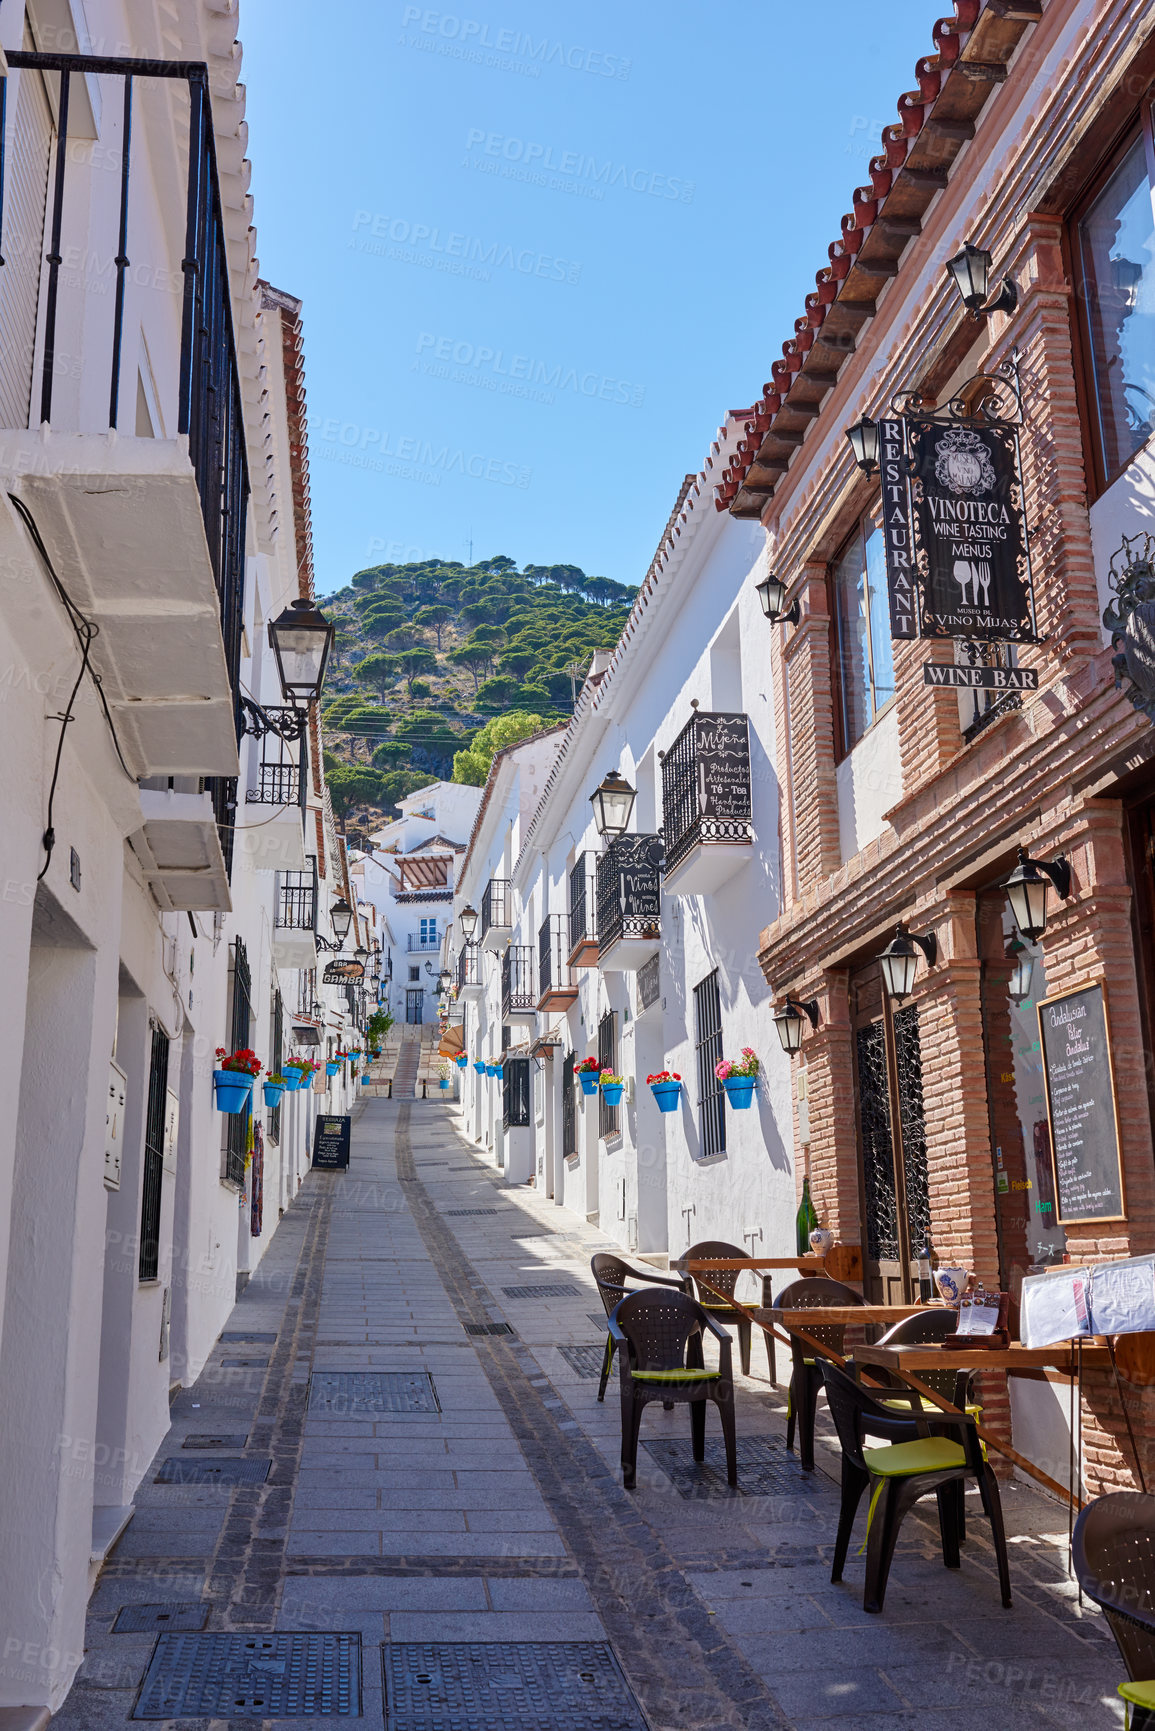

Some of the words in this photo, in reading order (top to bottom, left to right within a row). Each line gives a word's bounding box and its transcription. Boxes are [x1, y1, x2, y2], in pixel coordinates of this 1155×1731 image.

[927, 496, 1010, 524] VINOTECA
[884, 422, 912, 633] RESTAURANT
[933, 521, 960, 536] WINE
[963, 523, 1007, 539] TASTING
[952, 543, 992, 558] MENUS
[957, 607, 981, 616] MUSEO
[935, 613, 973, 626] VINO
[976, 615, 1018, 628] MIJAS
[928, 666, 983, 686] WINE
[992, 670, 1036, 688] BAR
[697, 731, 747, 750] Mijeña
[710, 762, 750, 774] Productos
[711, 783, 723, 794] Té
[731, 785, 747, 795] Tea
[710, 795, 751, 806] Handmade
[627, 875, 658, 892] Vinos
[629, 894, 658, 914] Wines
[323, 974, 363, 986] GAMBA
[1036, 1200, 1052, 1213] Ham
